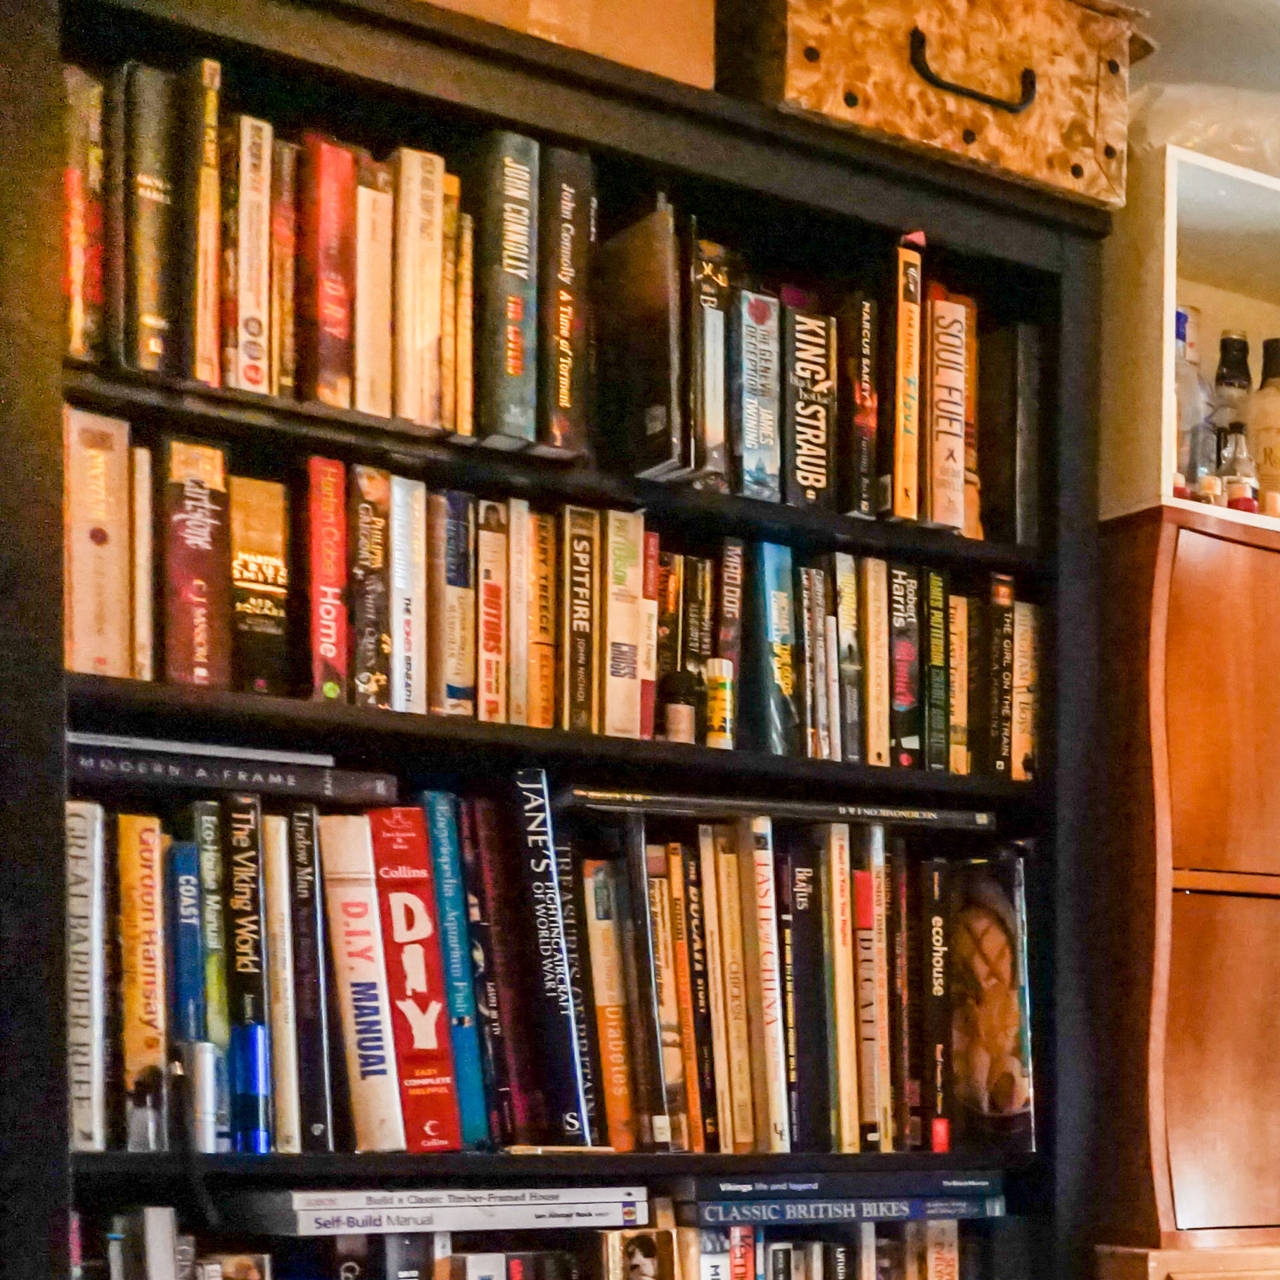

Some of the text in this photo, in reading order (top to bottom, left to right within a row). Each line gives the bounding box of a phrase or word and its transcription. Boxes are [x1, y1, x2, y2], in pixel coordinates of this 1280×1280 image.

[503, 157, 530, 280] JOHN CONNOLLY
[558, 183, 576, 284] John Connolly
[559, 290, 573, 301] A
[559, 306, 573, 337] Time
[559, 357, 573, 407] Torment
[795, 315, 826, 380] KING
[862, 301, 871, 398] MARCUS SAKEY
[935, 315, 964, 441] SOUL FUEL
[746, 398, 760, 448] TWINING
[761, 408, 774, 445] JAMES
[795, 401, 827, 488] STRAUB
[320, 585, 340, 658] Home
[404, 597, 412, 615] THE
[483, 581, 502, 655] MOTORS
[539, 575, 549, 634] TREECE
[572, 539, 590, 633] SPITFIRE
[723, 586, 740, 619] DOG
[892, 569, 907, 627] Harris
[906, 578, 918, 623] Robert
[577, 638, 586, 702] JOHN NICHOL
[610, 642, 638, 680] CROSS
[1001, 612, 1012, 757] THE GIRL ON THE TRAIN
[294, 812, 313, 898] Lindow Man
[518, 779, 553, 873] JANE'S
[178, 874, 198, 926] COAST
[201, 815, 223, 949] Eco-House Manual
[230, 810, 260, 974] The Viking World
[378, 865, 429, 879] Collins
[67, 812, 91, 1110] GREAT BARRIER REEF
[138, 827, 163, 1051] Gordon Ramsay's
[532, 881, 556, 987] OF WORLD WAR
[545, 881, 570, 1016] FIGHTING AIRCRAFT
[689, 885, 707, 1014] DUCATI STORY
[930, 915, 948, 997] ecohouse
[341, 901, 388, 1081] D.I.Y. MANUAL
[453, 981, 471, 1013] Fish
[760, 950, 778, 1027] CHINA
[858, 937, 876, 1042] DUCATI
[604, 1006, 629, 1097] Diabetes
[420, 1138, 448, 1147] Collins
[314, 1213, 434, 1230] Self-Build Manual
[364, 1194, 395, 1206] Build
[406, 1193, 443, 1205] Classic
[528, 1191, 560, 1201] House
[703, 1200, 910, 1222] CLASSIC BRITISH BIKES
[719, 1182, 753, 1193] Vikings
[835, 1248, 846, 1280] Lynda
